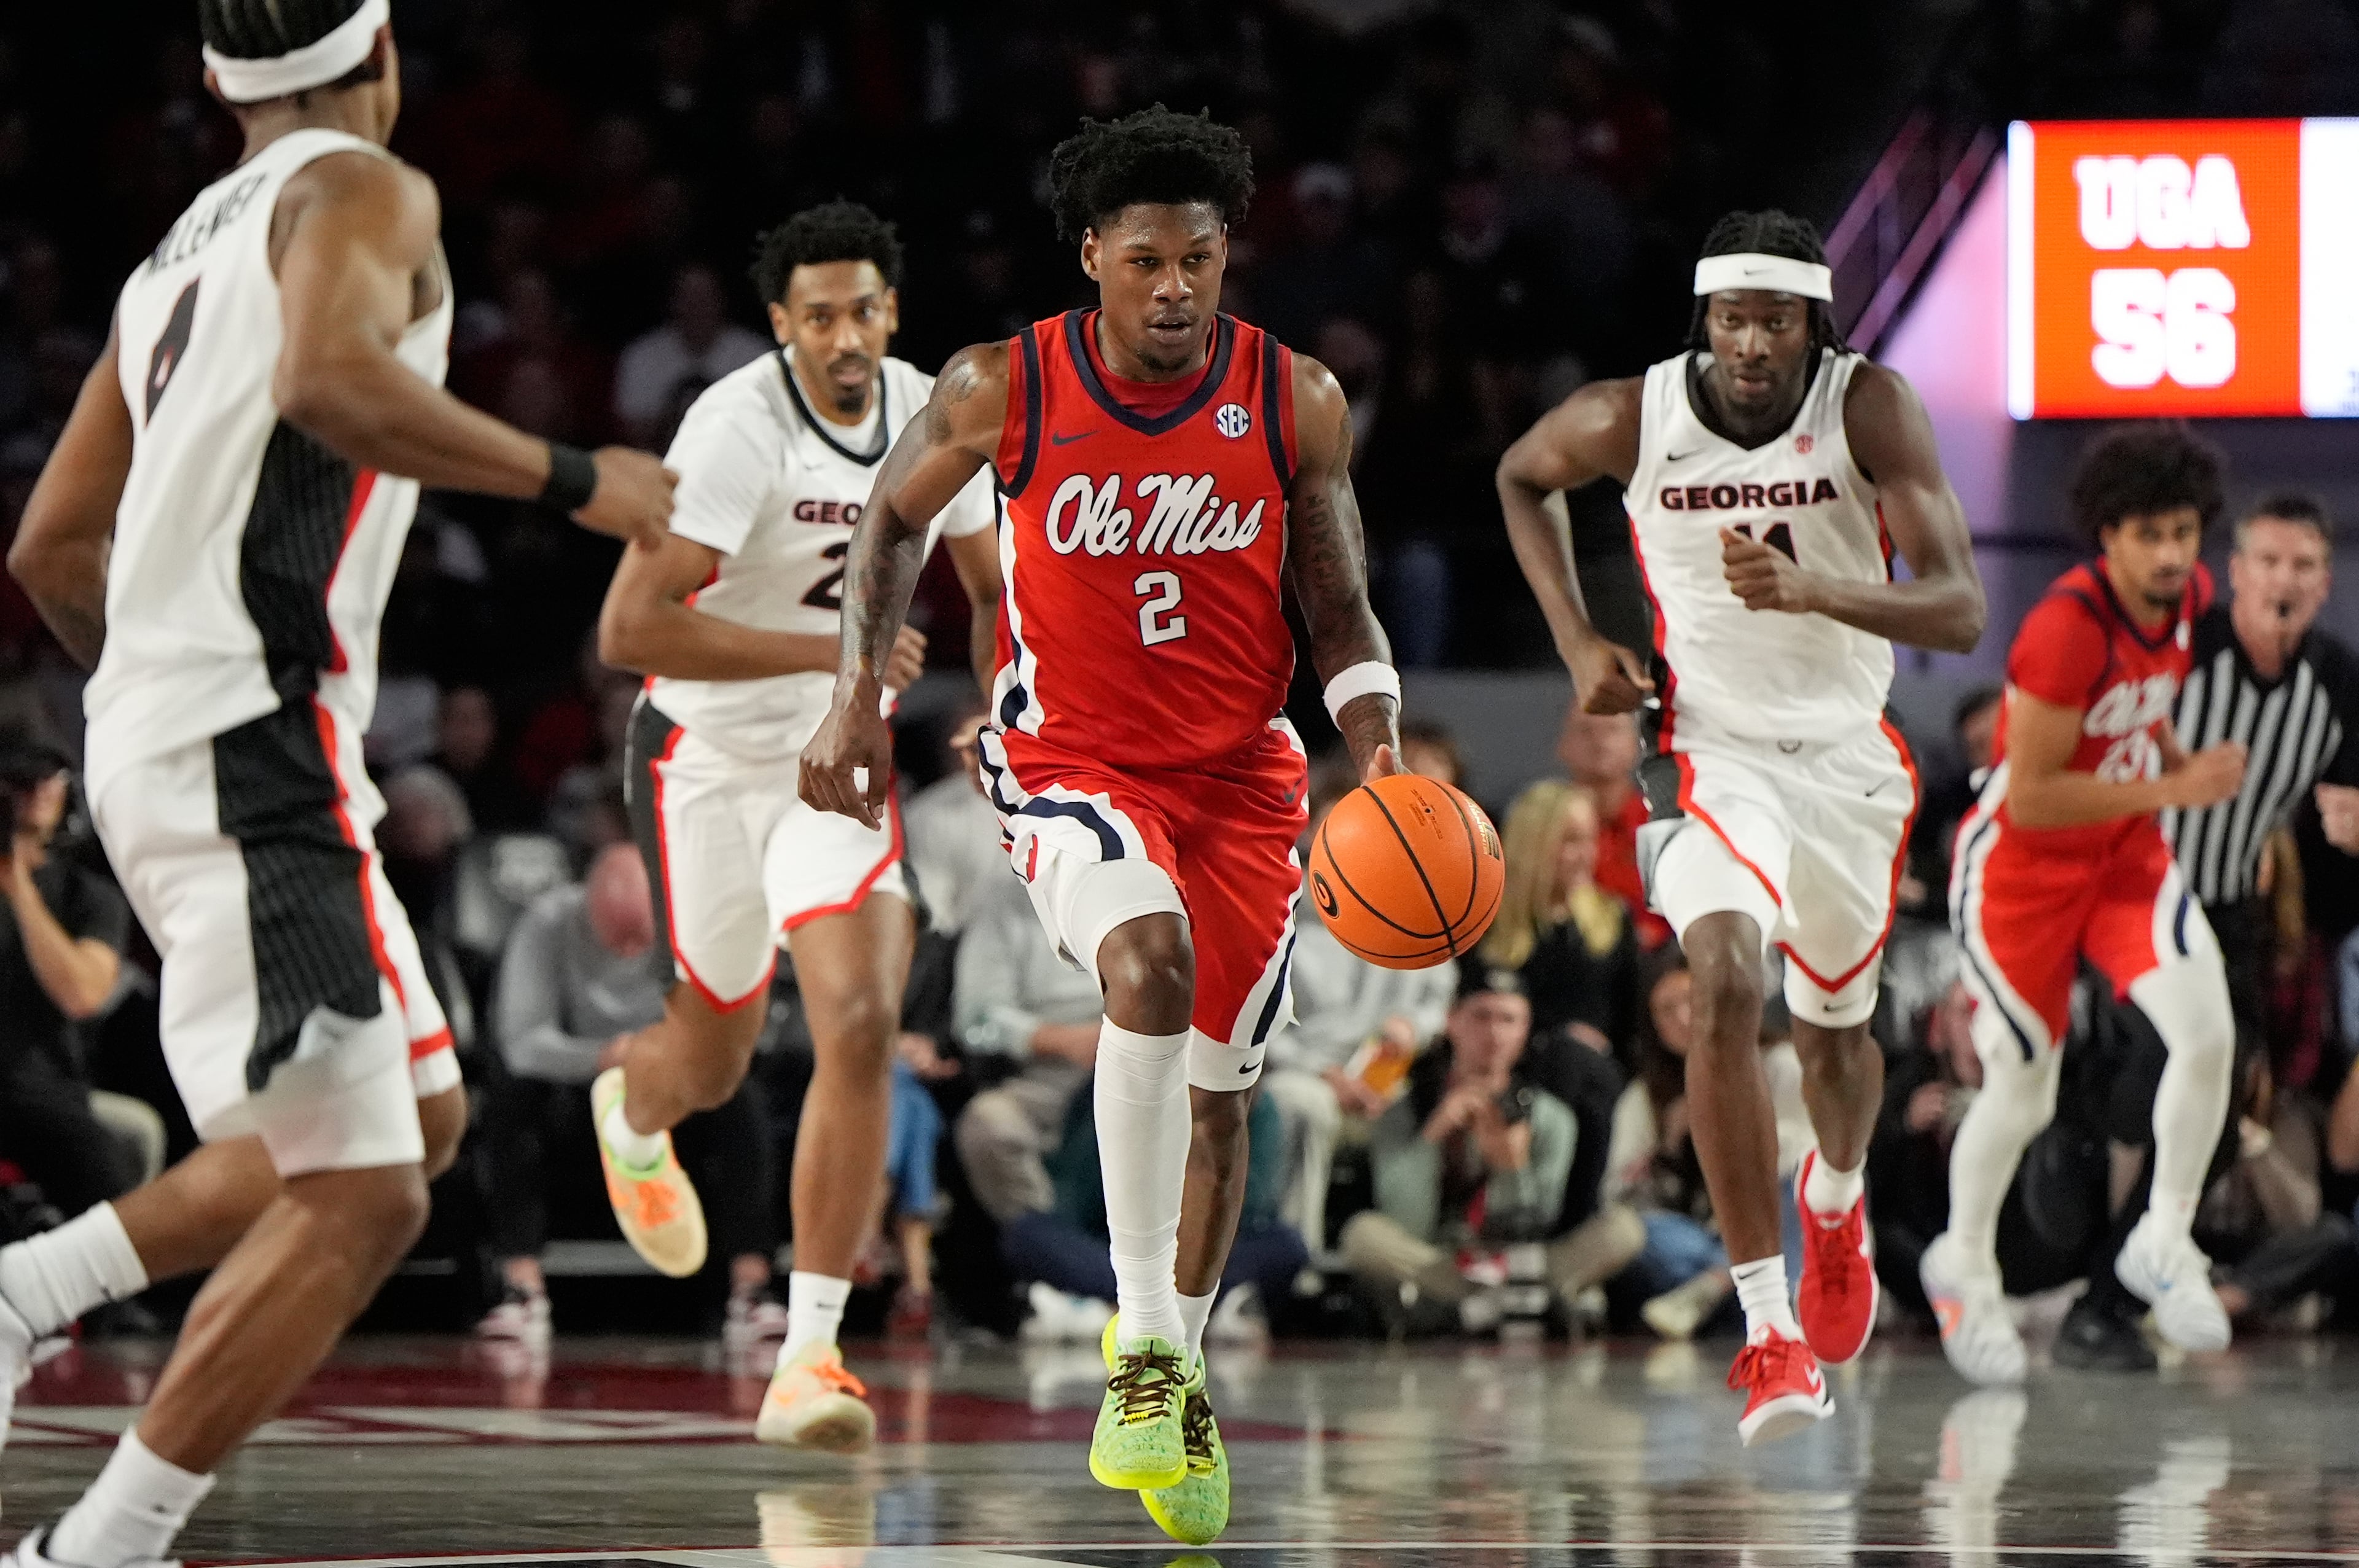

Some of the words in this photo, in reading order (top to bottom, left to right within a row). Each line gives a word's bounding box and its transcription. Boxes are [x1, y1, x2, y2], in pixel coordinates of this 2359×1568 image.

[2072, 154, 2251, 250] UGA
[2091, 268, 2236, 389] 56
[1216, 403, 1250, 438] SEC
[1046, 473, 1133, 557] Ole
[1135, 473, 1267, 556] Miss
[1660, 477, 1839, 510] GEORGIA
[1134, 571, 1187, 647] 2
